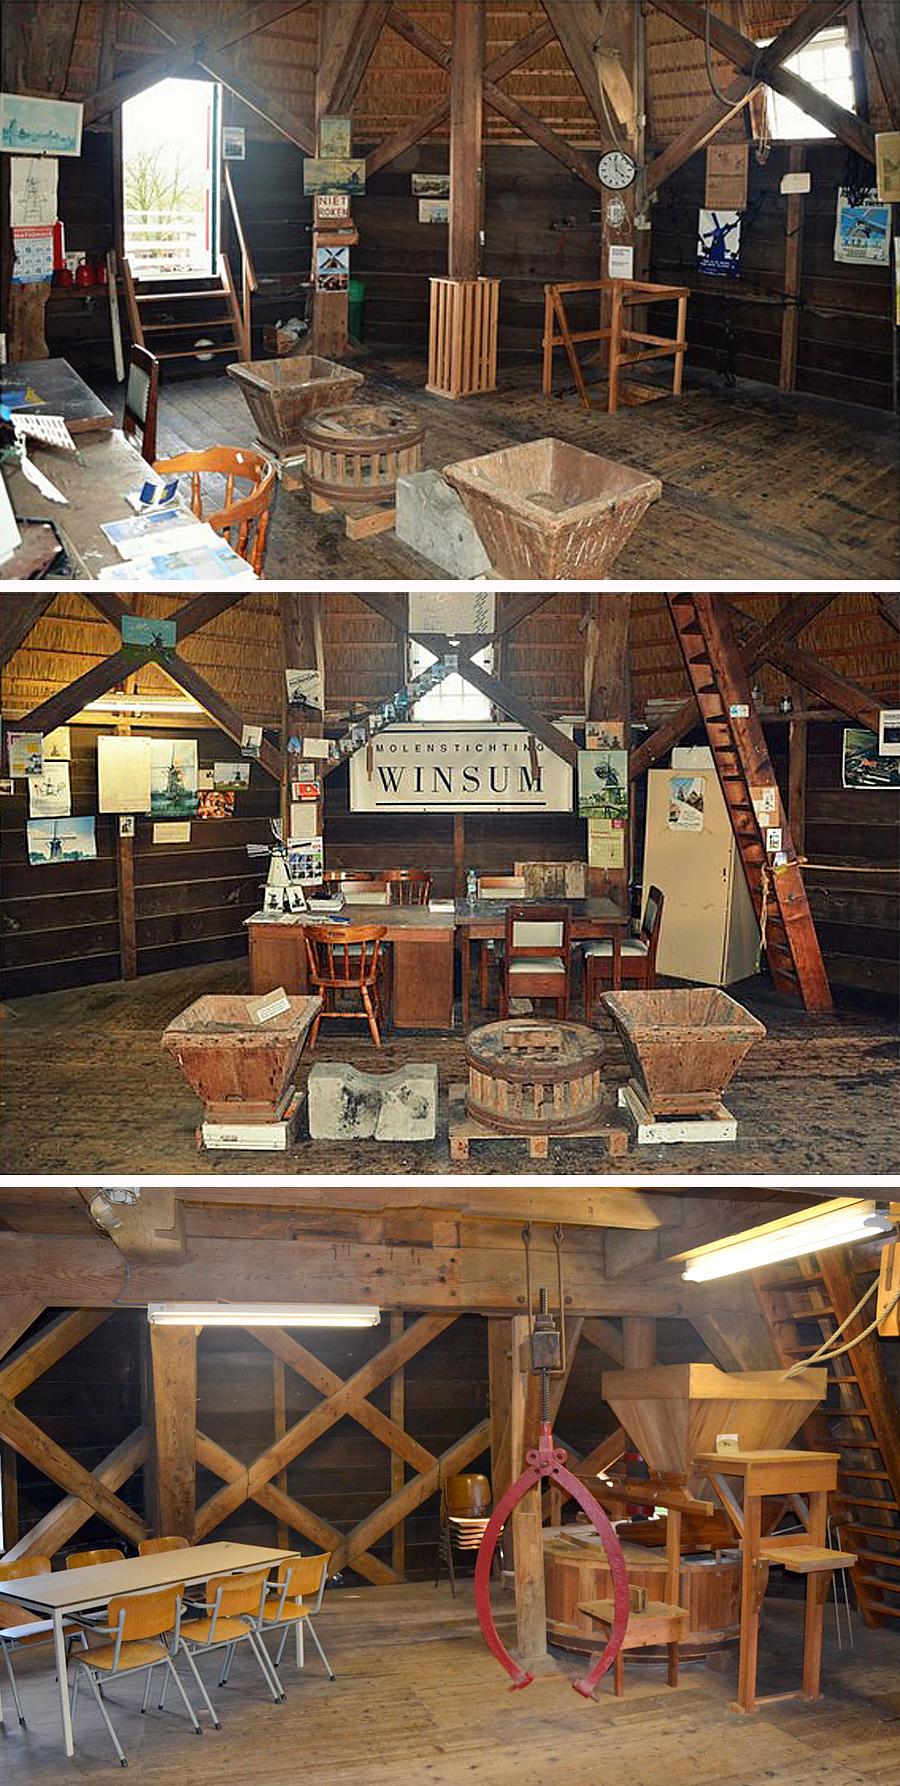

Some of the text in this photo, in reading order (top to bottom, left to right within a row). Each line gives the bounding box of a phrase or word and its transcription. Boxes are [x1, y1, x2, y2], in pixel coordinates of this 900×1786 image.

[318, 196, 348, 206] NIET
[375, 743, 544, 752] MOLENSTICHTING
[376, 766, 544, 793] WINSUM
